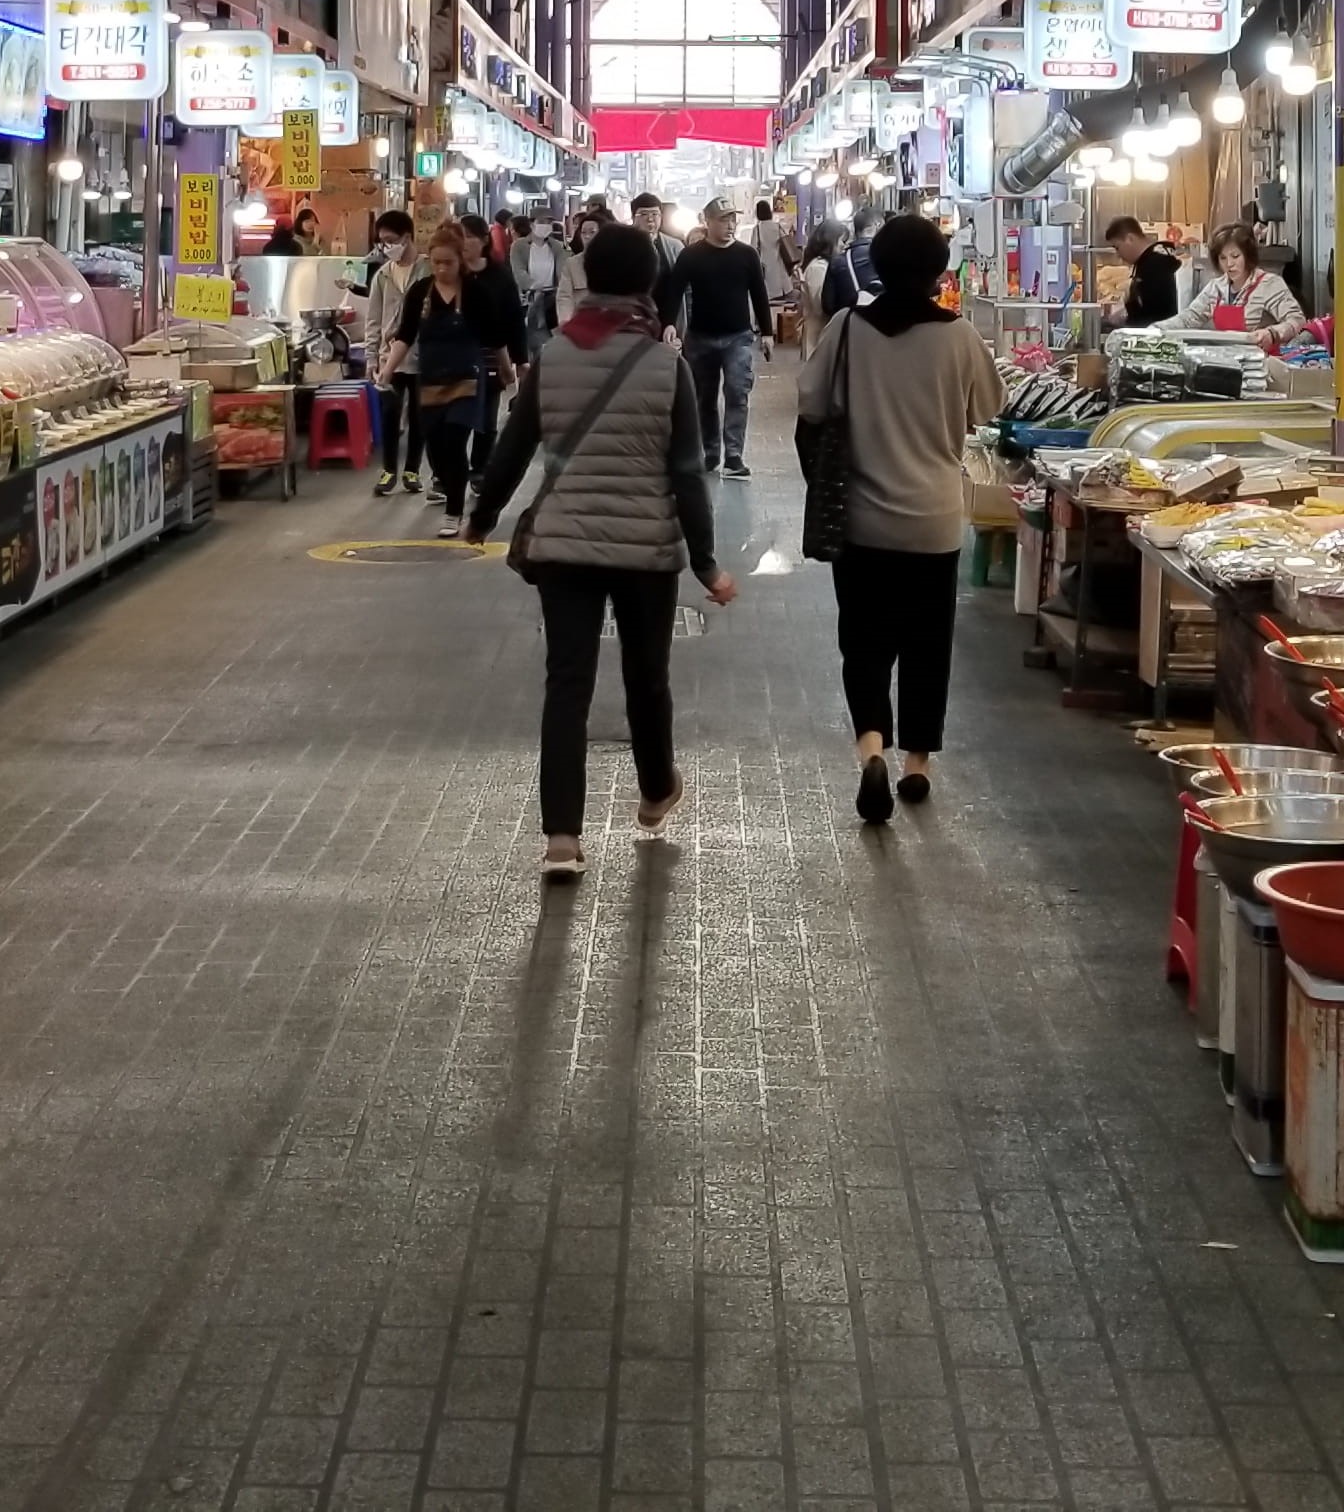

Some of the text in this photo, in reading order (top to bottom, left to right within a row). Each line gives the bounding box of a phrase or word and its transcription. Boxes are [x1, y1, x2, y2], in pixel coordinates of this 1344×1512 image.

[287, 112, 315, 129] 보리
[291, 129, 313, 173] 비빔밥
[185, 178, 215, 196] 보리
[188, 198, 210, 245] 비빔밥
